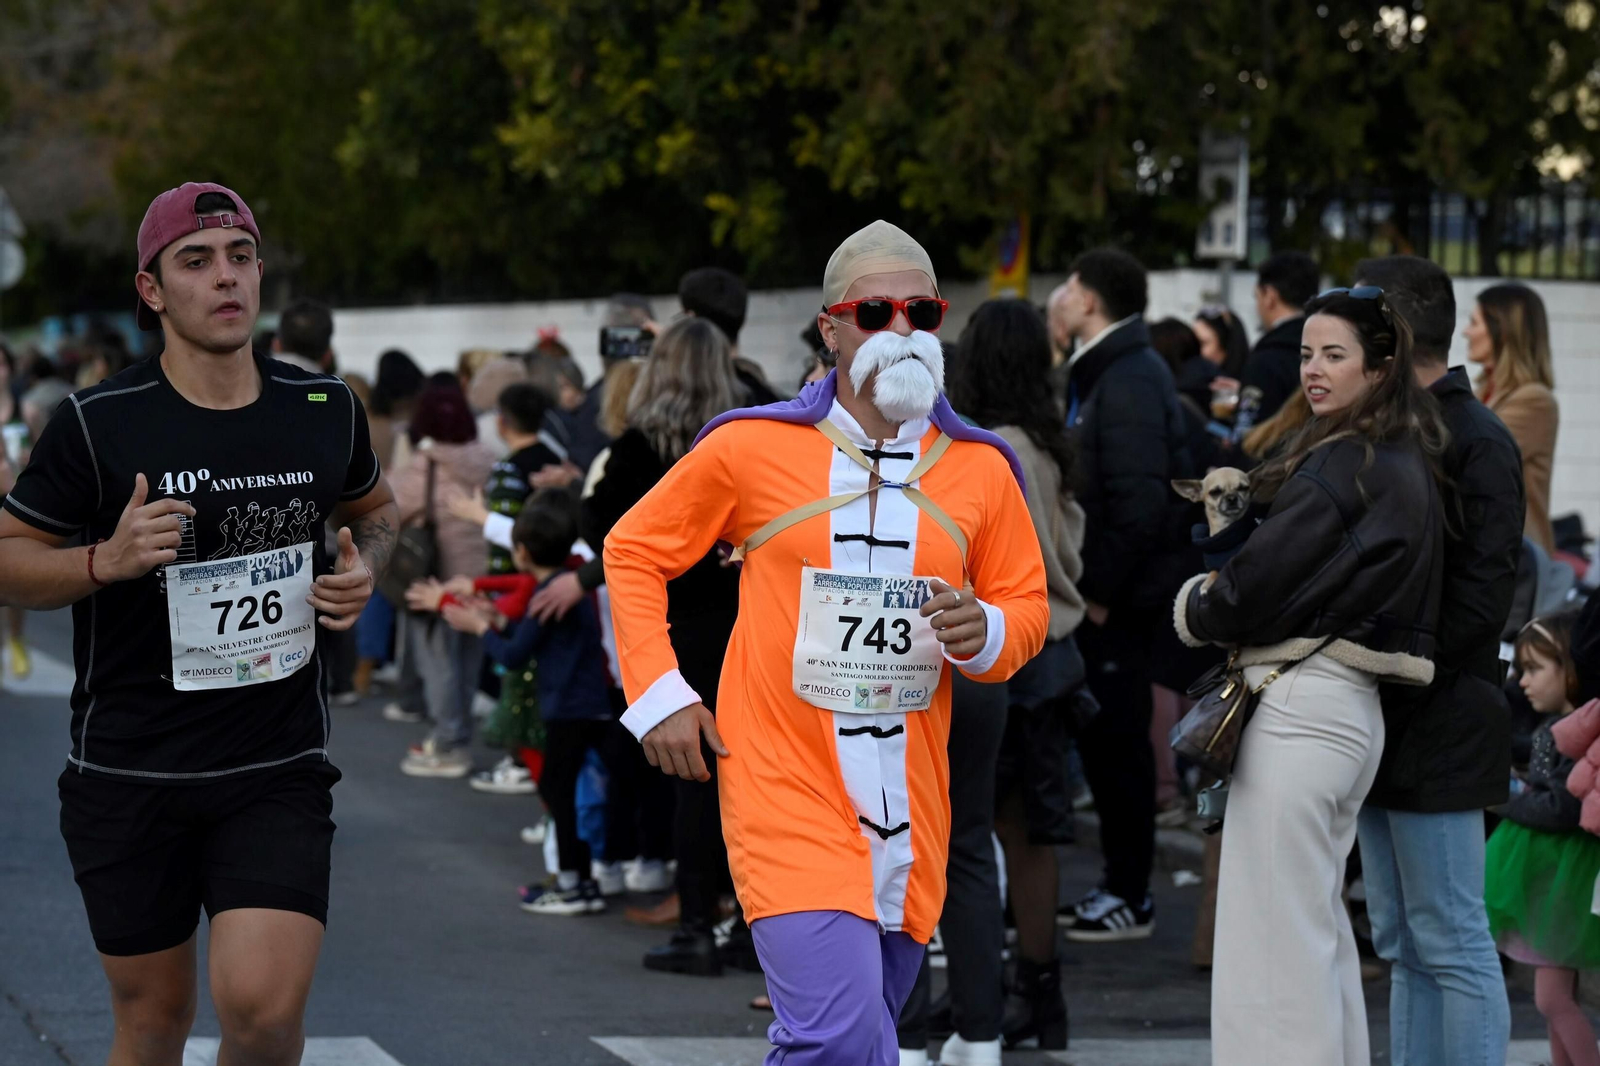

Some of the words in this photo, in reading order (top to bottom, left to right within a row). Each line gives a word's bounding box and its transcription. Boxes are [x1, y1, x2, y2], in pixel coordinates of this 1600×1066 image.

[210, 470, 314, 492] ANIVERSARIO
[249, 552, 281, 570] 2024
[179, 566, 206, 575] CIRCUITO
[206, 562, 241, 573] PROVINCIAL
[179, 571, 213, 581] CARRERAS
[213, 566, 249, 577] POPULARES
[813, 580, 846, 589] CARRERAS
[847, 583, 883, 591] POPULARES
[814, 573, 840, 581] CIRCUITO
[840, 576, 875, 585] PROVINCIAL
[883, 579, 917, 593] 2024
[210, 590, 283, 635] 726
[198, 644, 217, 653] SAN
[218, 636, 264, 651] SILVESTRE
[265, 624, 311, 642] CORDOBESA
[838, 615, 912, 655] 743
[240, 648, 263, 656] MEDINA
[263, 640, 290, 651] BORREGO
[285, 650, 303, 663] GCC
[192, 667, 233, 677] IMDECO
[819, 659, 838, 668] SAN
[839, 661, 889, 671] SILVESTRE
[889, 663, 938, 671] CORDOBESA
[830, 672, 863, 680] SANTIAGO
[811, 684, 851, 698] IMDECO
[904, 690, 923, 698] GCC
